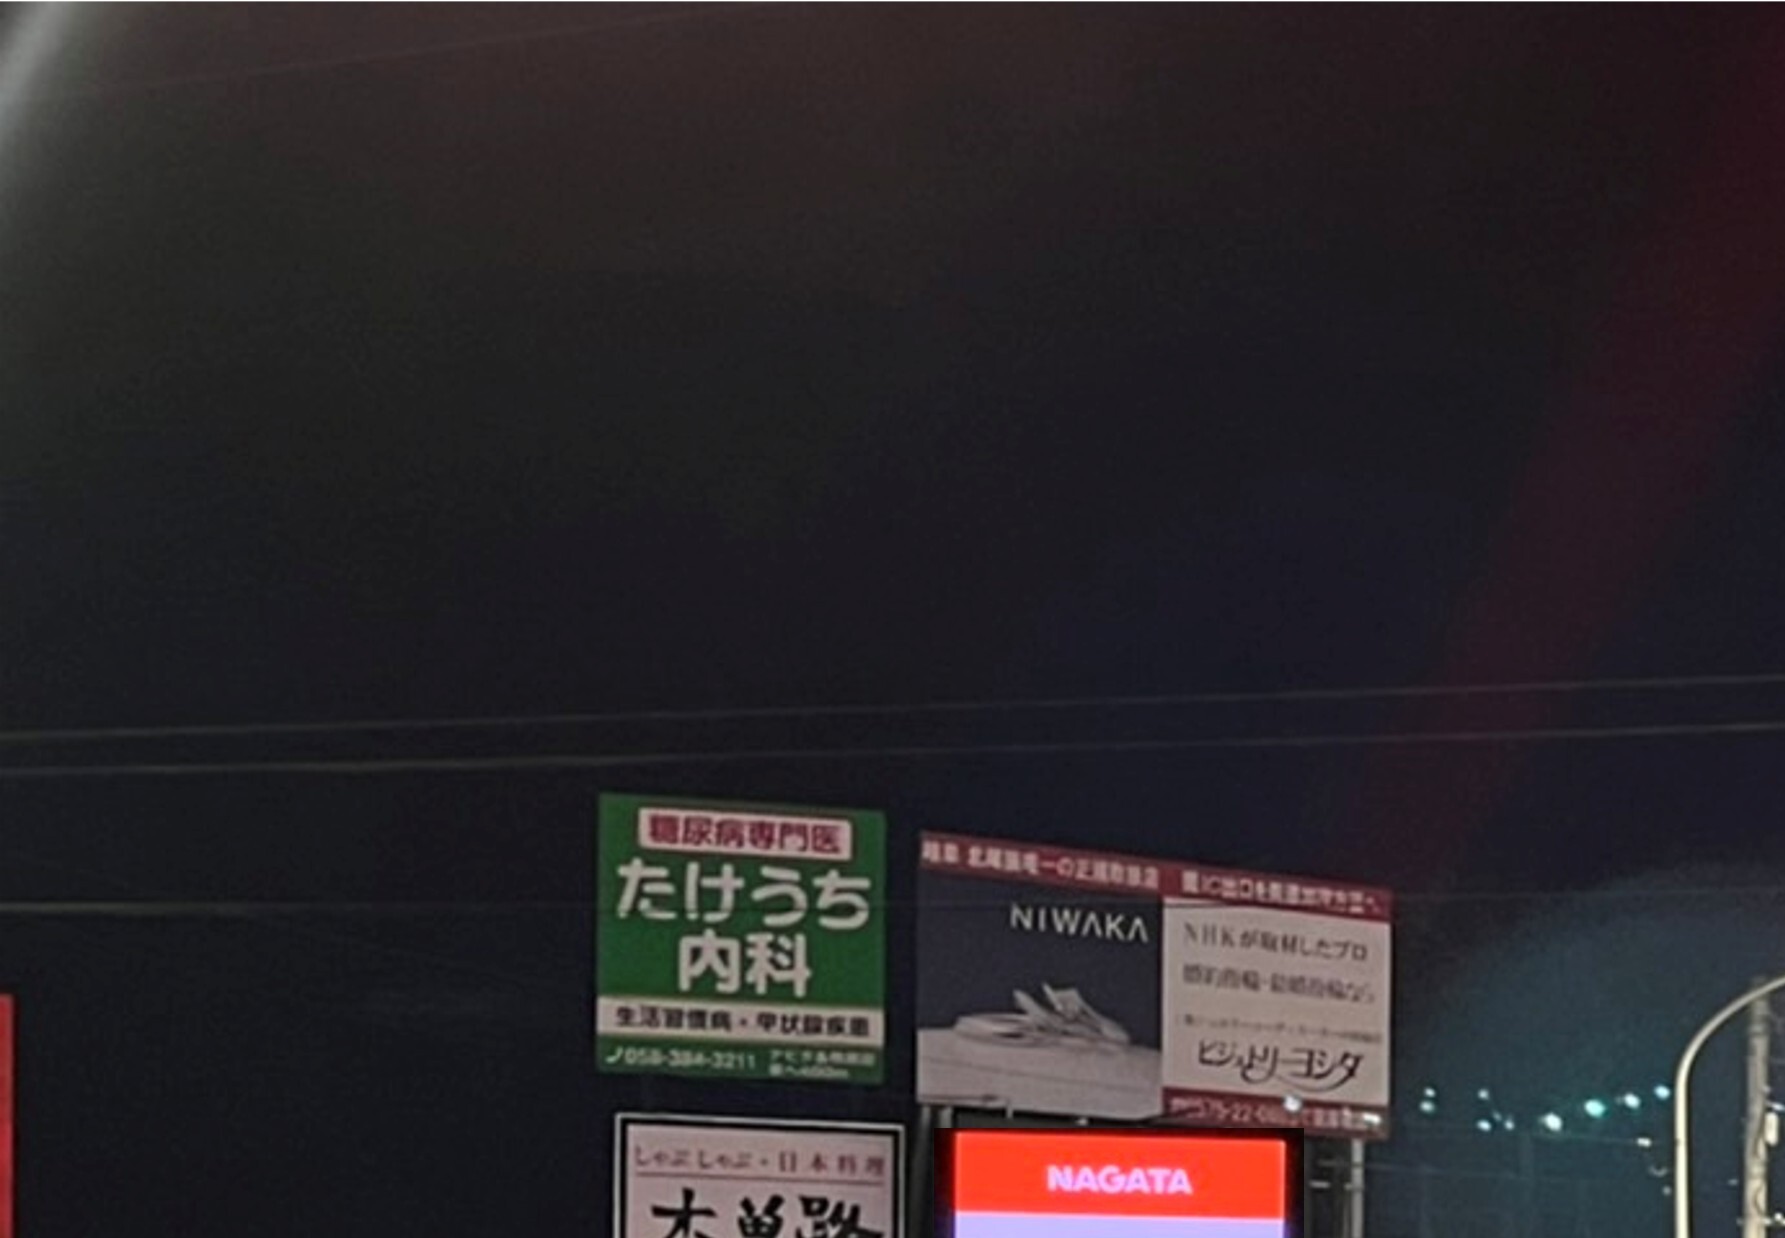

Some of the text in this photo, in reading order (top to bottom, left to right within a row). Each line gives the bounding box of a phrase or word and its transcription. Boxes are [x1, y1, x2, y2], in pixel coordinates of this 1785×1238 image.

[649, 815, 842, 854] 糖尿病専門医
[617, 857, 872, 930] たけうち
[1010, 903, 1149, 944] NIWAKA
[678, 928, 813, 998] 内科
[635, 1145, 886, 1177] しゃぶしゃぶ・日本料理
[1047, 1165, 1193, 1195] NAGATA
